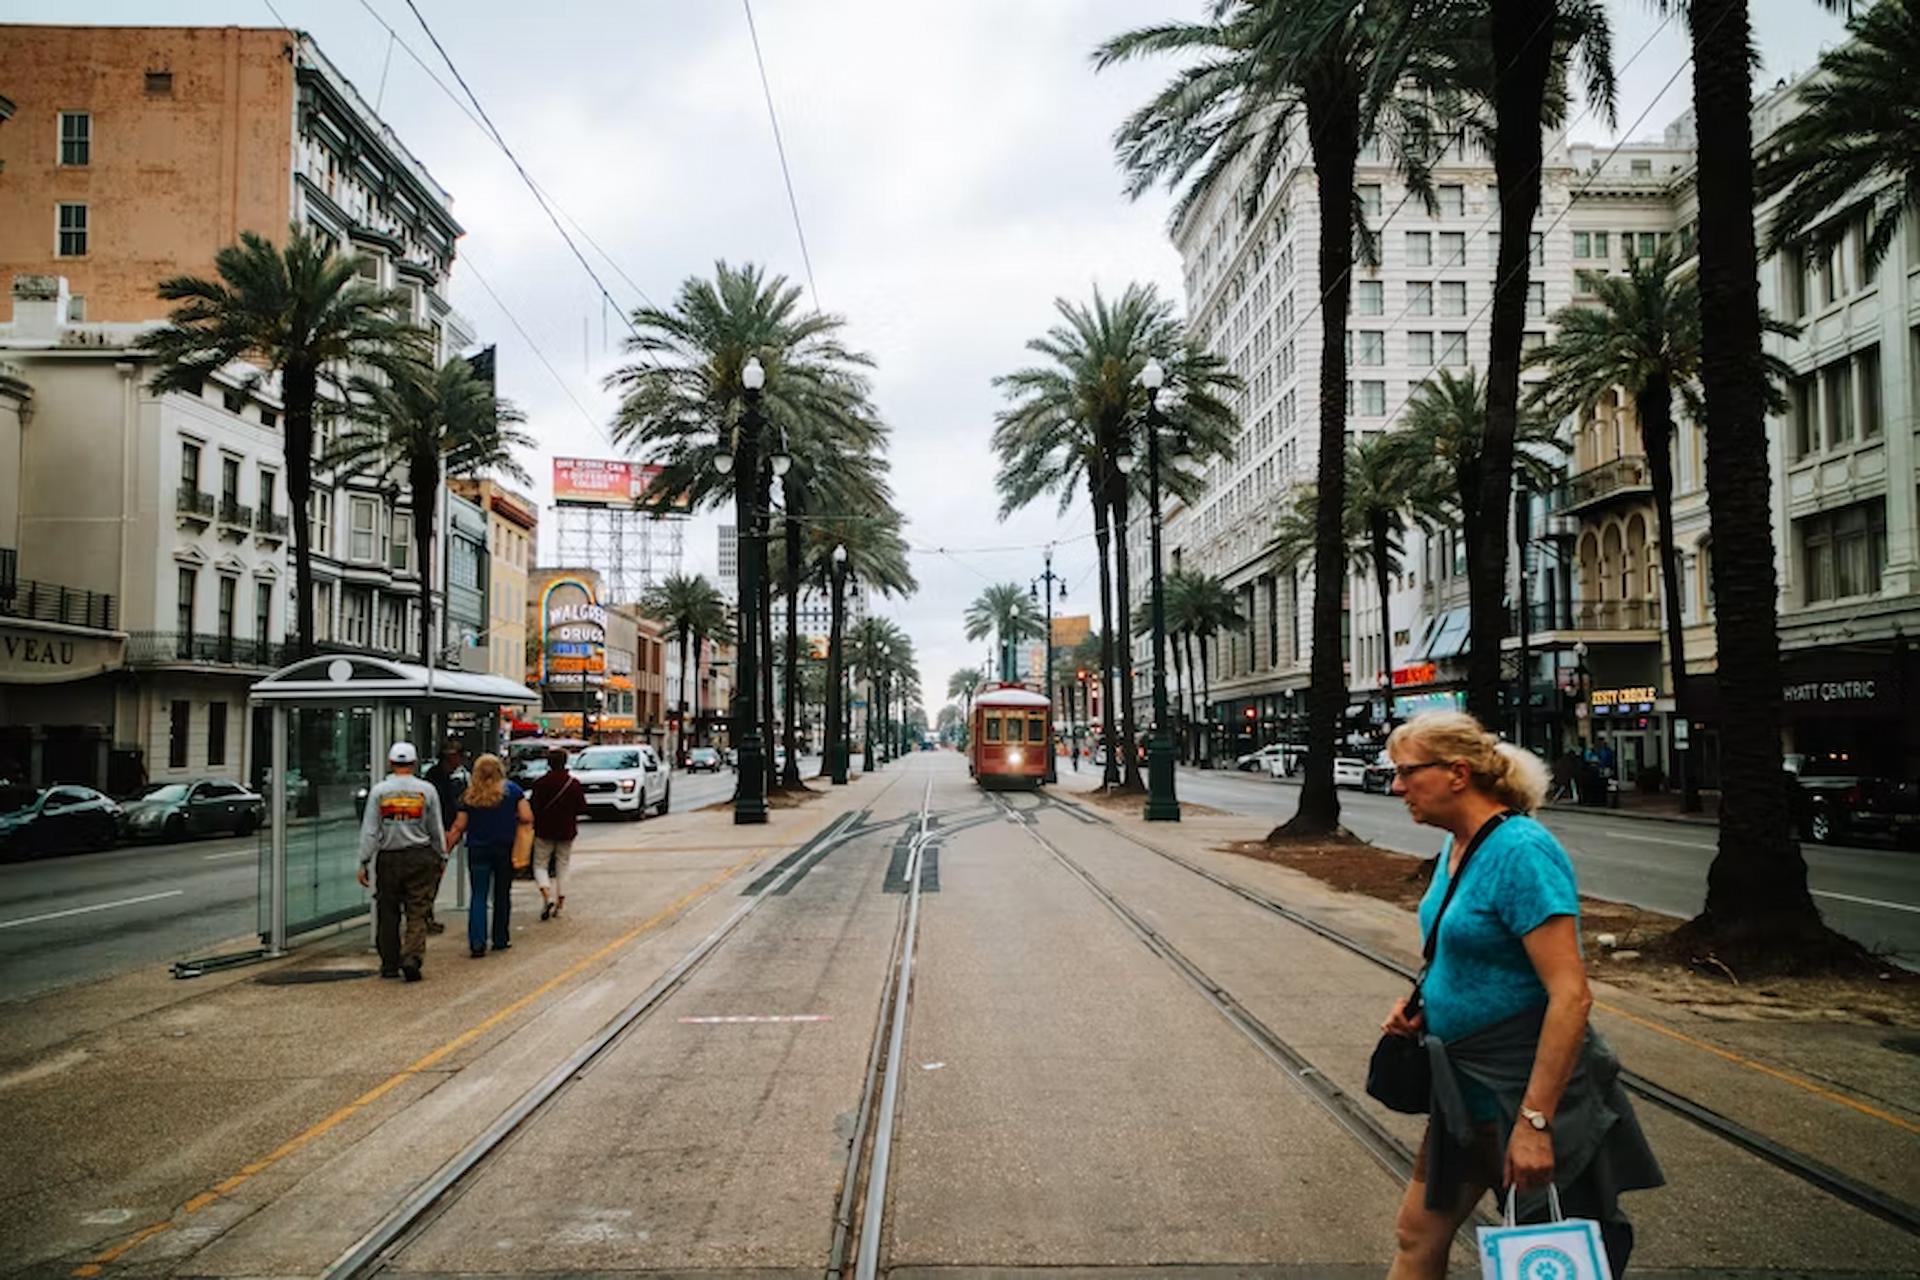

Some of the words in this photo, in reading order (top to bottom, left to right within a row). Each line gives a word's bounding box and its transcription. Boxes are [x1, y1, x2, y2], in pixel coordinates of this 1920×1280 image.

[4, 636, 75, 665] VEAU
[1783, 683, 1818, 700] HYATT
[1820, 681, 1875, 701] CENTRIC
